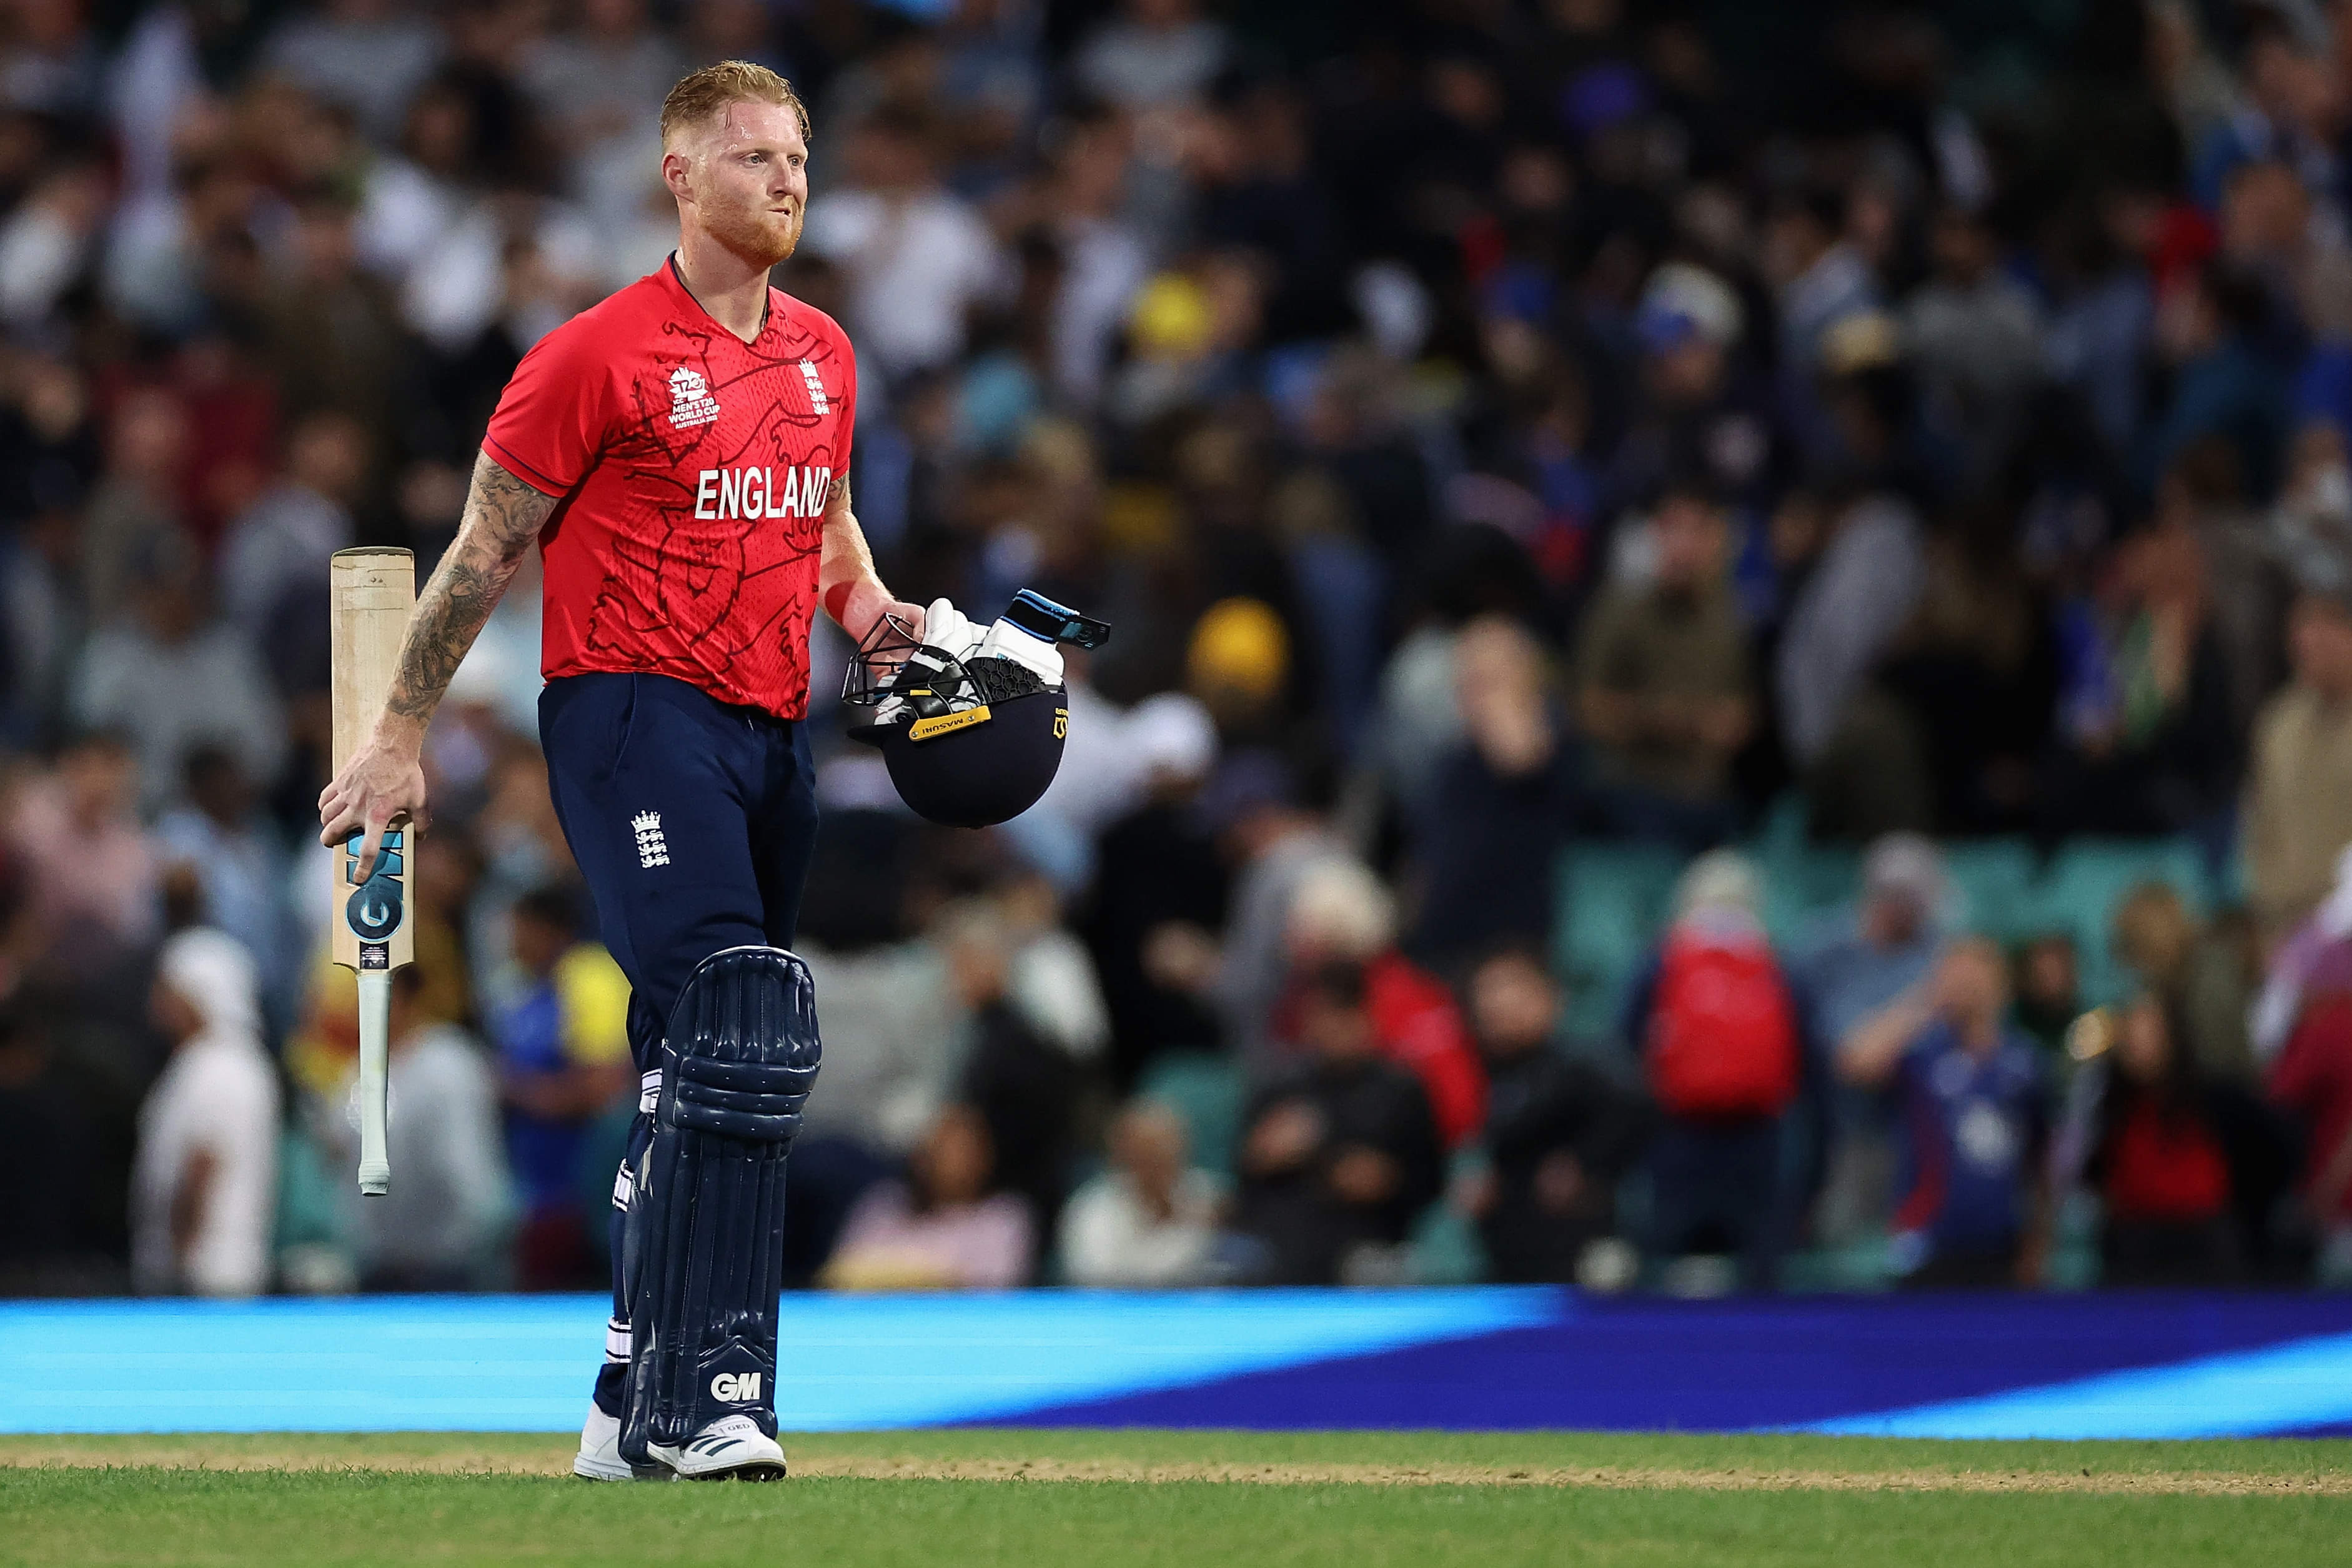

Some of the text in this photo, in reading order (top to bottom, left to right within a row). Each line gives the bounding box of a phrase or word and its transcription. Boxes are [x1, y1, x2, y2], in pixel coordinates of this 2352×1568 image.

[668, 405, 720, 424] WORLD CUP
[673, 397, 715, 414] MEN'S T20
[675, 417, 706, 429] AUSTRALIA
[695, 466, 831, 520] ENGLAND
[922, 718, 963, 734] MASURI
[710, 1372, 761, 1402] GM
